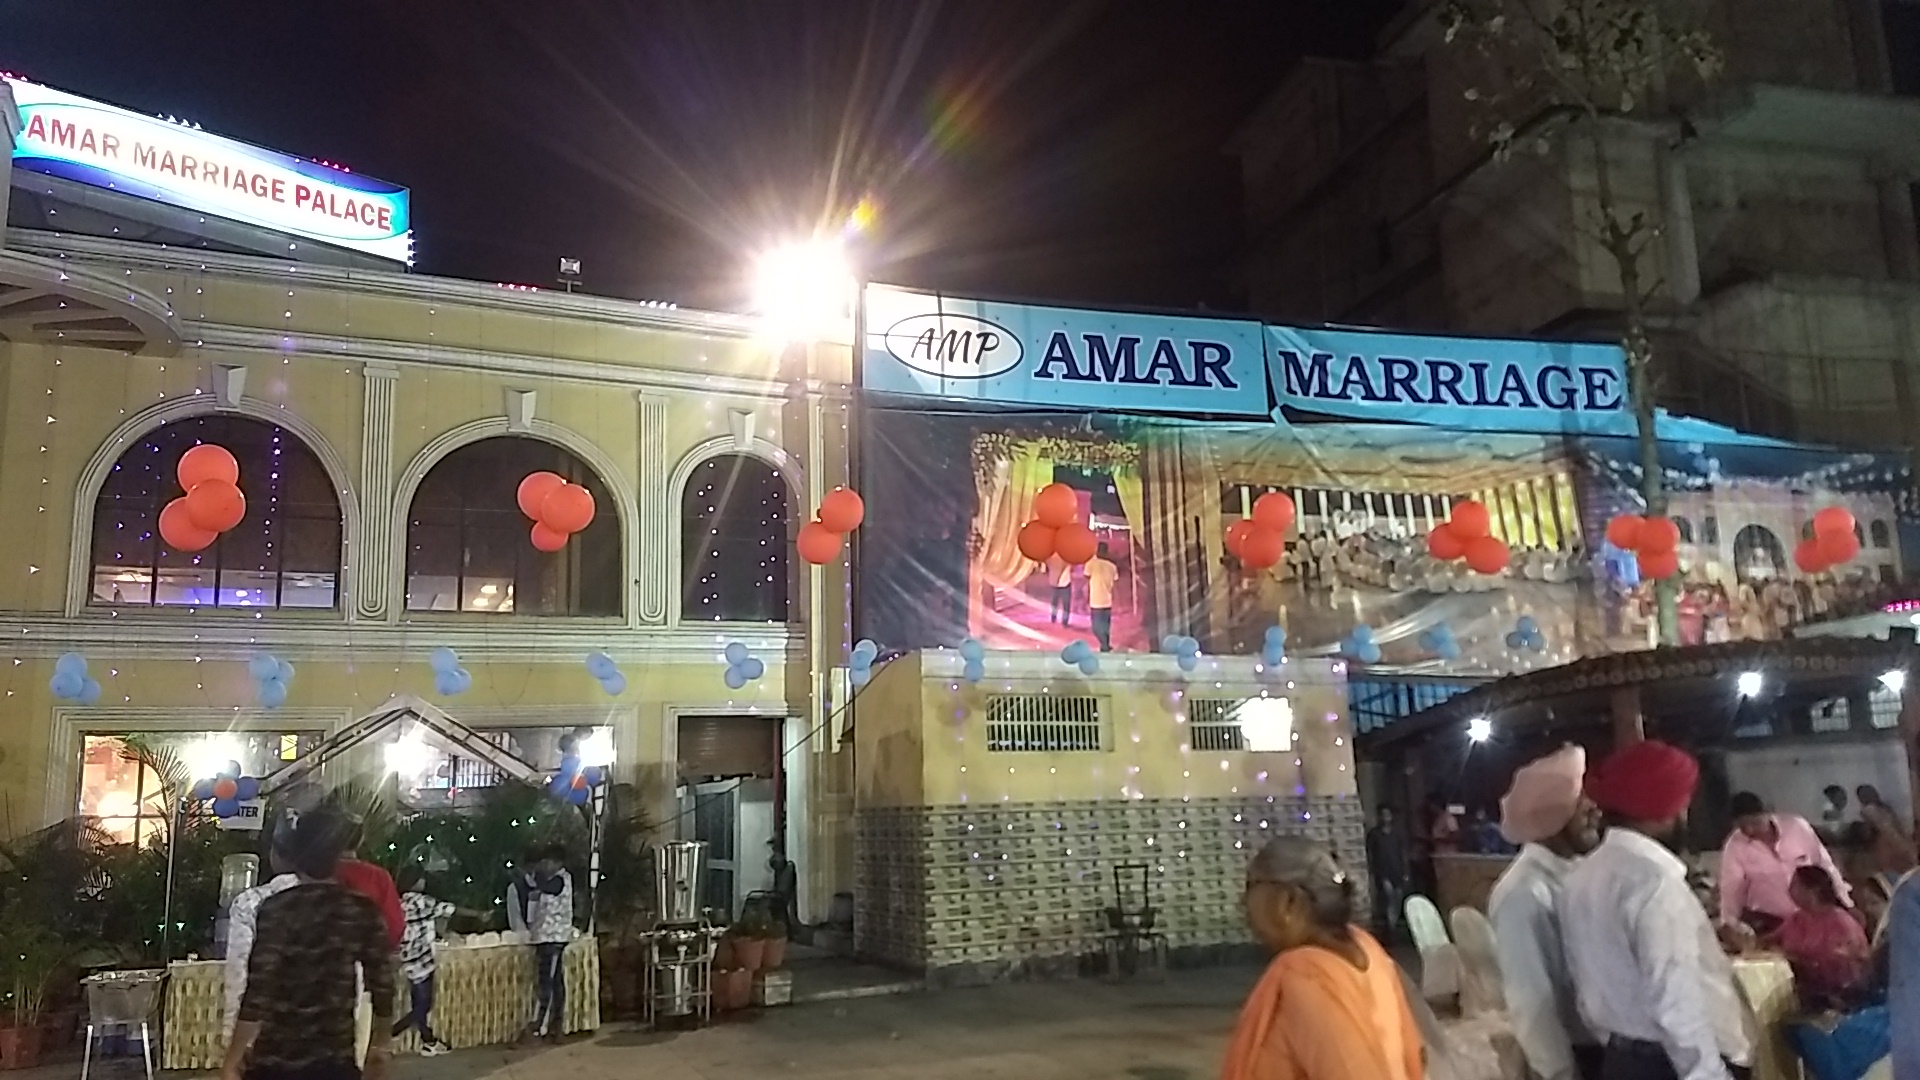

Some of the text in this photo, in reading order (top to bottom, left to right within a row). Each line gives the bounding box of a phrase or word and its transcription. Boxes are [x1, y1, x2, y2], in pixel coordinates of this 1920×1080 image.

[27, 114, 391, 231] AMAR MARRIAGE PALACE
[909, 328, 1000, 366] AMP
[1033, 331, 1623, 411] AMAR MARRIAGE
